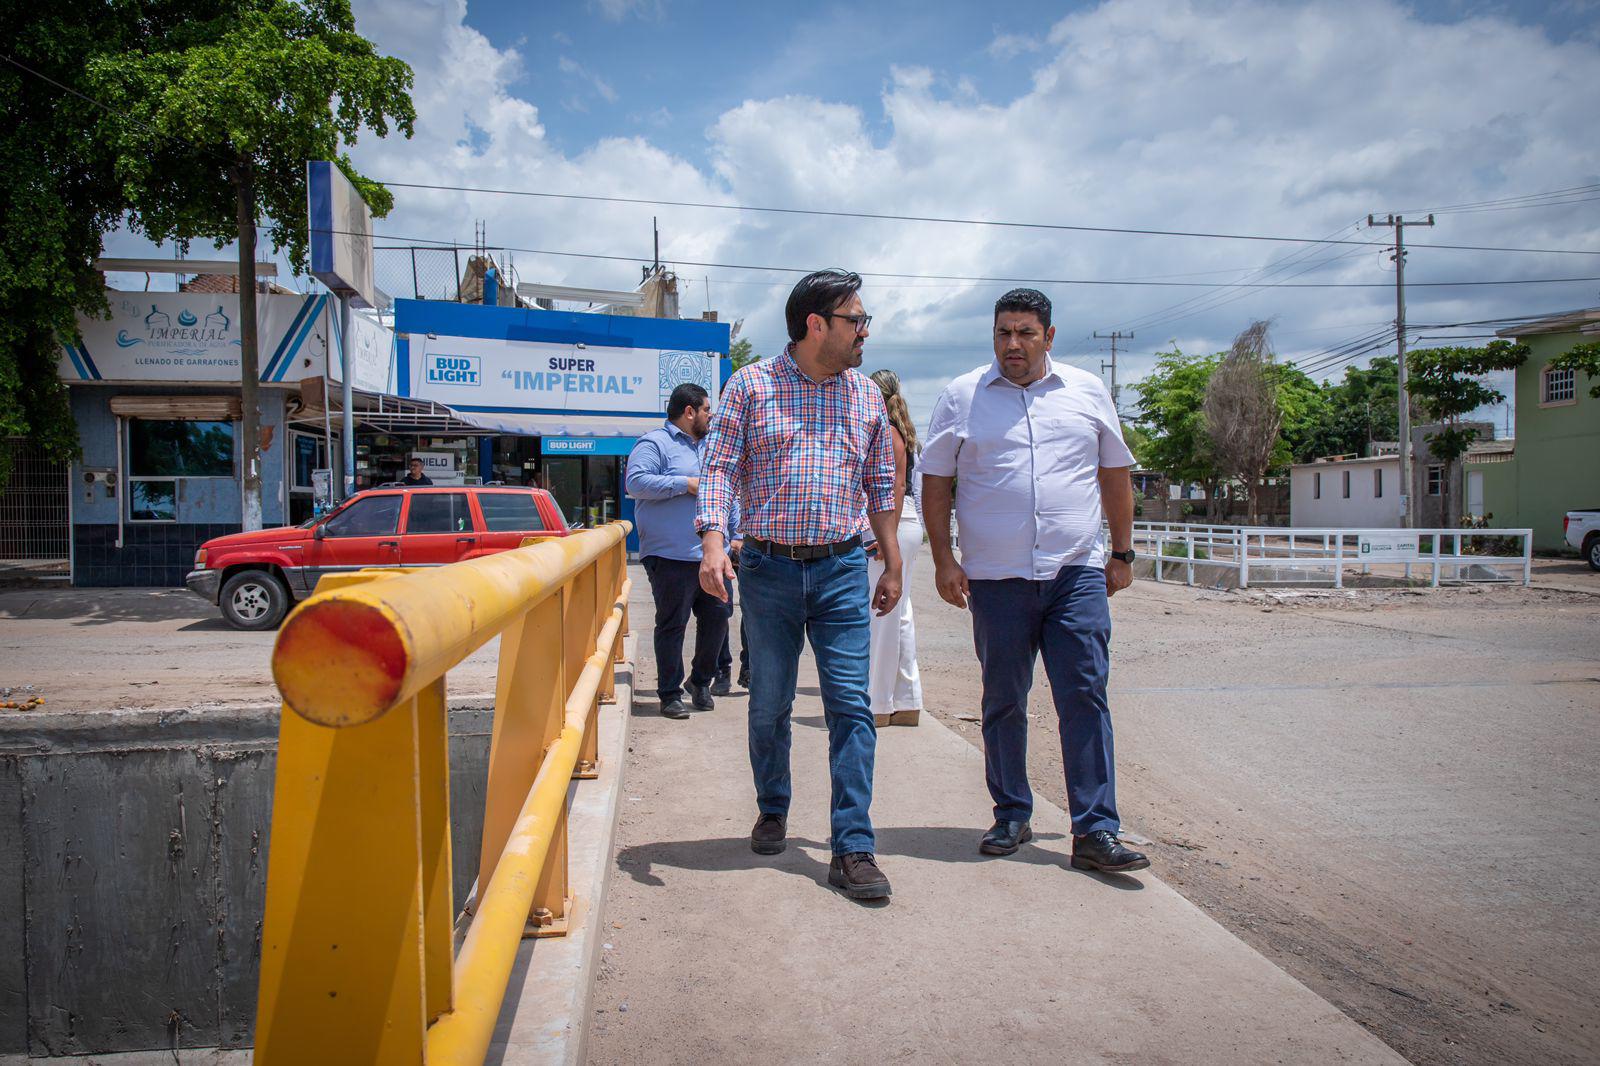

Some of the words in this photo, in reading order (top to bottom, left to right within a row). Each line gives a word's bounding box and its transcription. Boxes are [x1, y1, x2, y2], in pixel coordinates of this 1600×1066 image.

[150, 328, 226, 341] IMPERIAL
[135, 358, 171, 366] LLENADO
[173, 358, 183, 366] DE
[436, 357, 471, 370] BUD
[549, 357, 595, 372] SUPER
[430, 369, 478, 382] LIGHT
[550, 441, 568, 449] BUD
